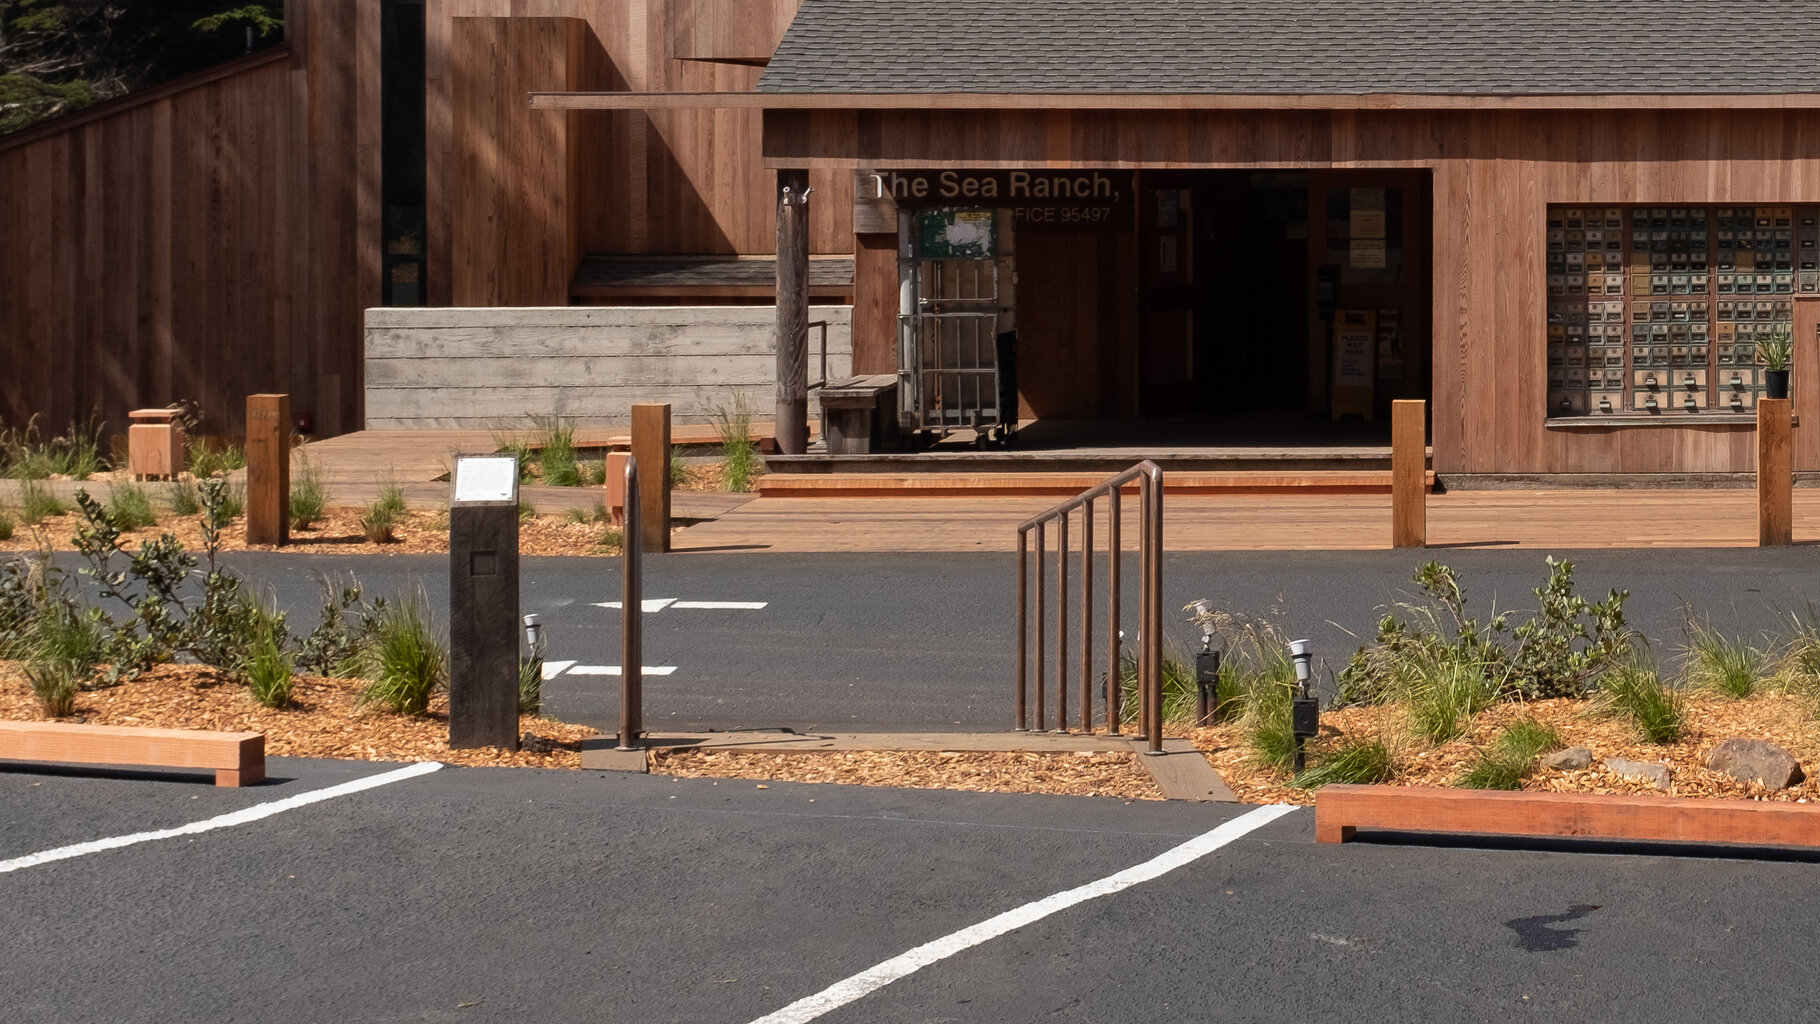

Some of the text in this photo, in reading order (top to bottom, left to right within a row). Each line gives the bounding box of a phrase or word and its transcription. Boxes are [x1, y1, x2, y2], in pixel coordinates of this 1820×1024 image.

[869, 171, 929, 199] The
[939, 170, 998, 199] Sea
[1009, 170, 1120, 203] Ranch,
[1014, 207, 1111, 223] FICE 95497
